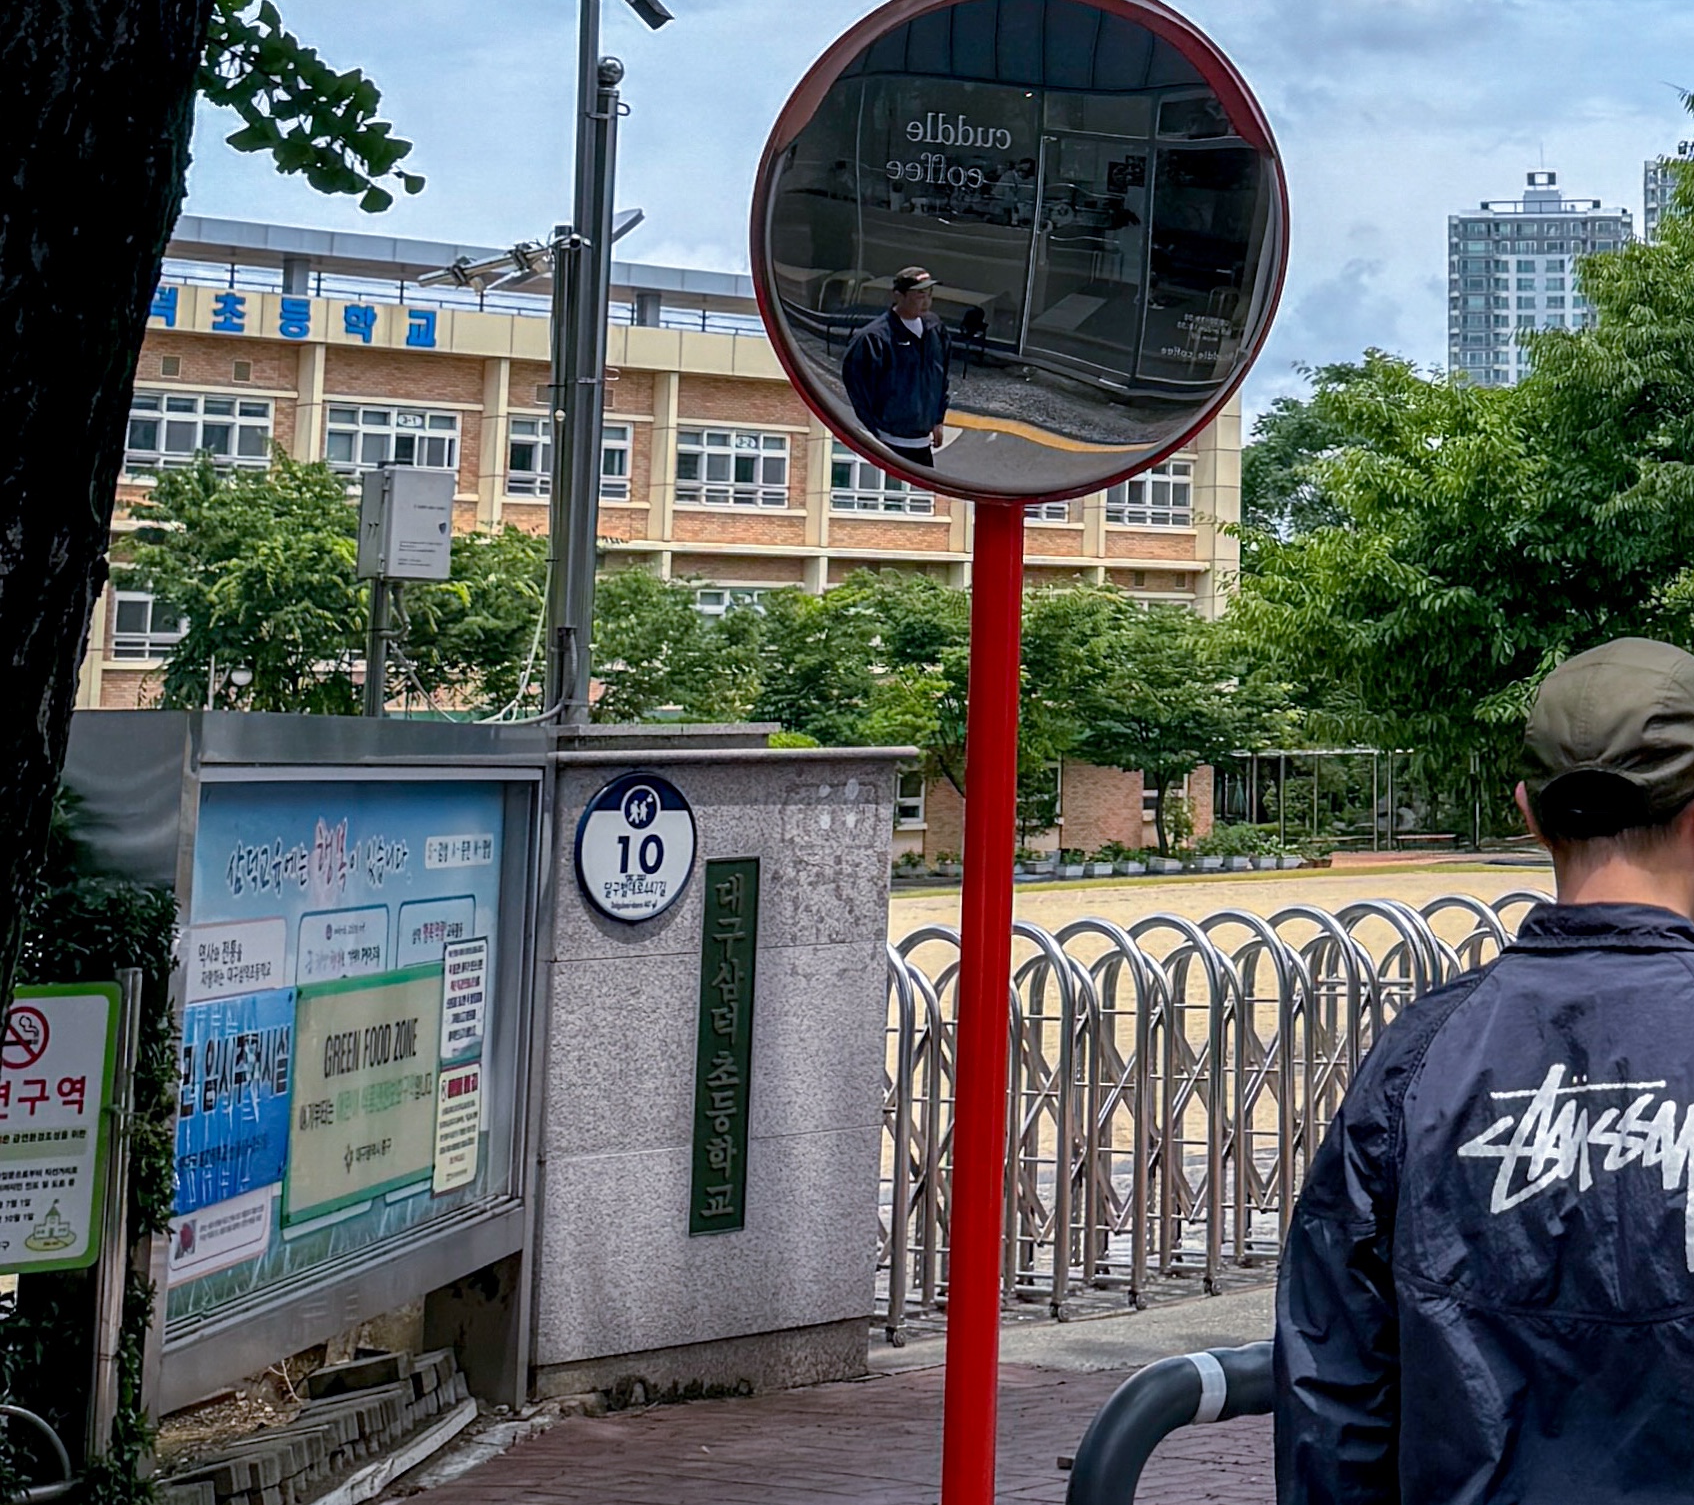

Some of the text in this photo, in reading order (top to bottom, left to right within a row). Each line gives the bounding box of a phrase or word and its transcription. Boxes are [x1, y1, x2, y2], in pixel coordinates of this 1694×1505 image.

[315, 819, 361, 894] 행복이
[617, 833, 665, 875] 10
[198, 939, 243, 967] 역사와 전통을
[324, 1017, 419, 1079] GREEN FOOD ZONE
